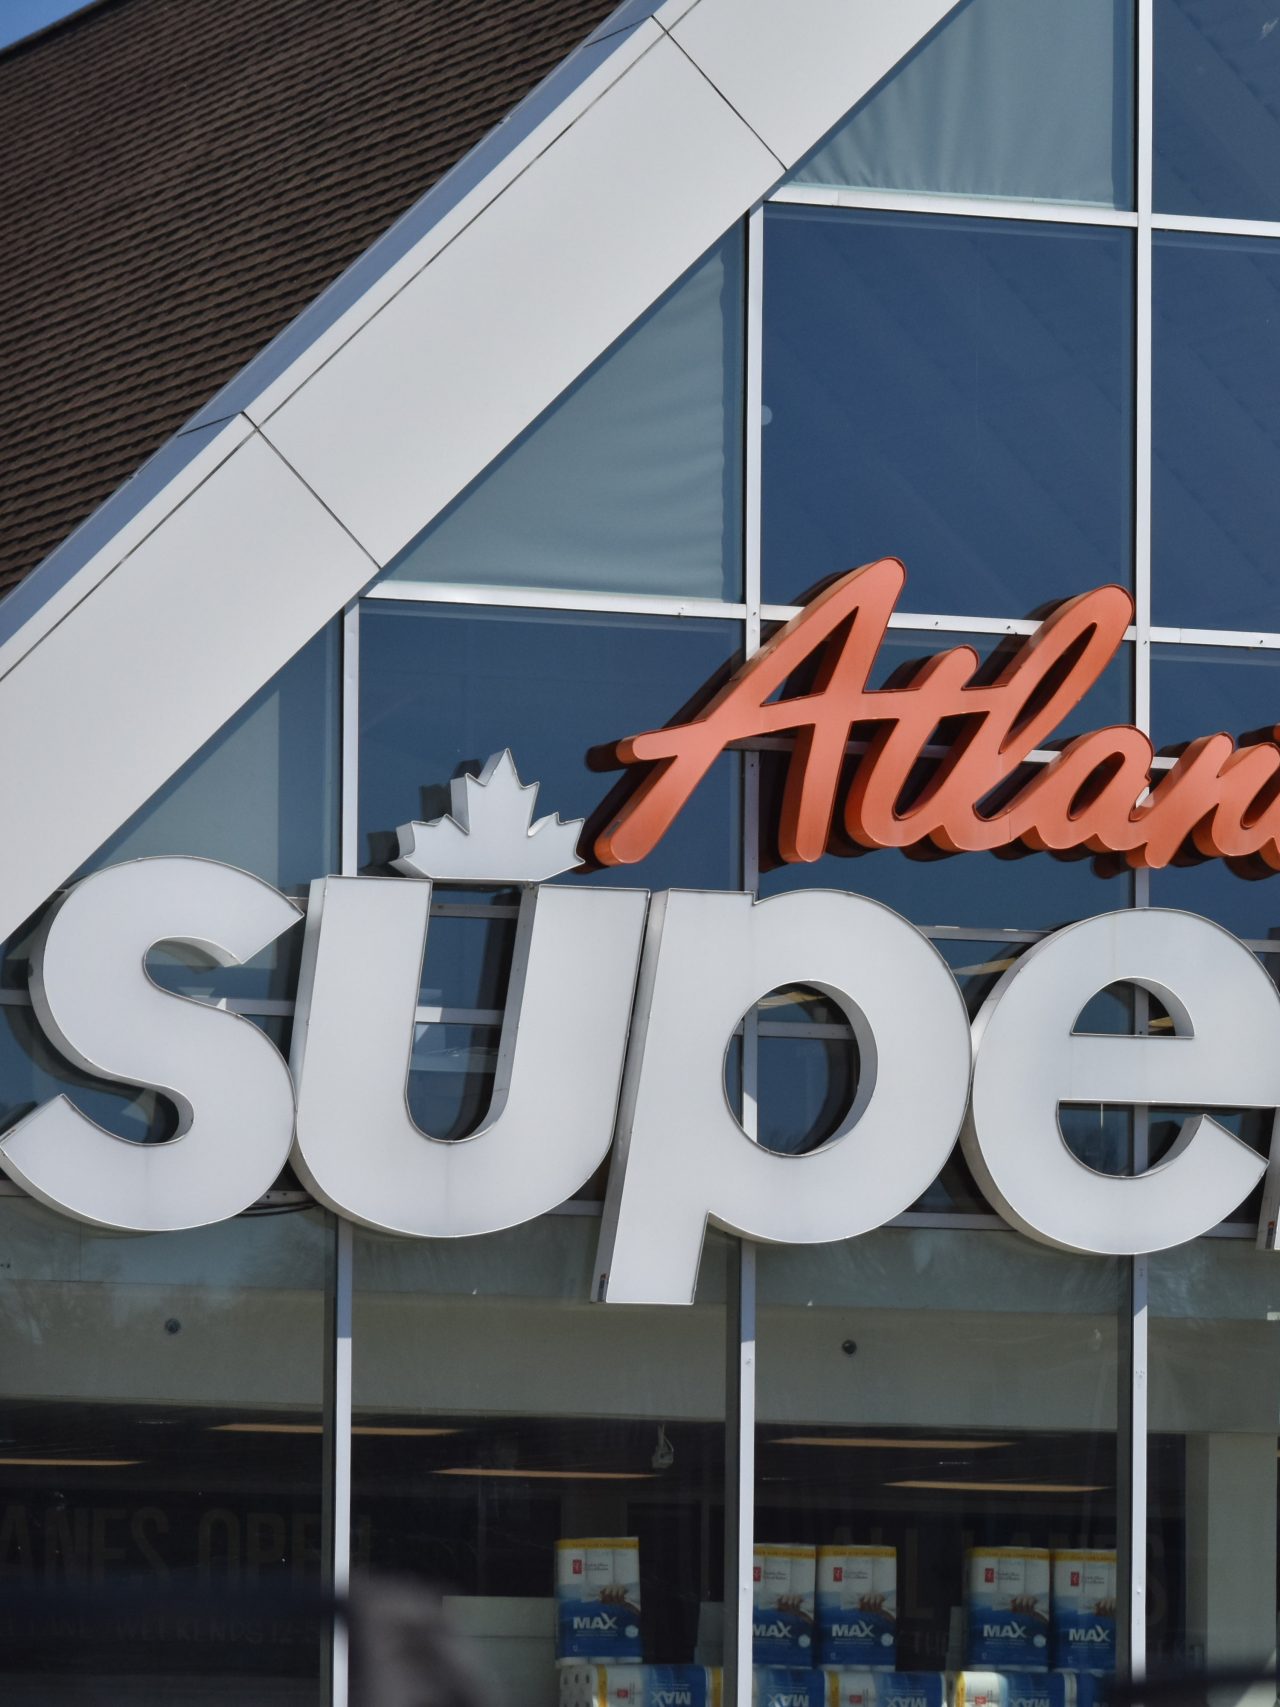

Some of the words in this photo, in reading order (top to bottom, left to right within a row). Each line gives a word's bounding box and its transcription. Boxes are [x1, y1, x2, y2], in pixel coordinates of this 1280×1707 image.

[573, 1612, 618, 1630] MAX
[753, 1620, 792, 1638] MAX
[832, 1620, 876, 1638] MAX
[983, 1620, 1027, 1638] MAX
[1069, 1624, 1111, 1642] MAX
[650, 1691, 691, 1707] MAX
[768, 1692, 810, 1707] MAX
